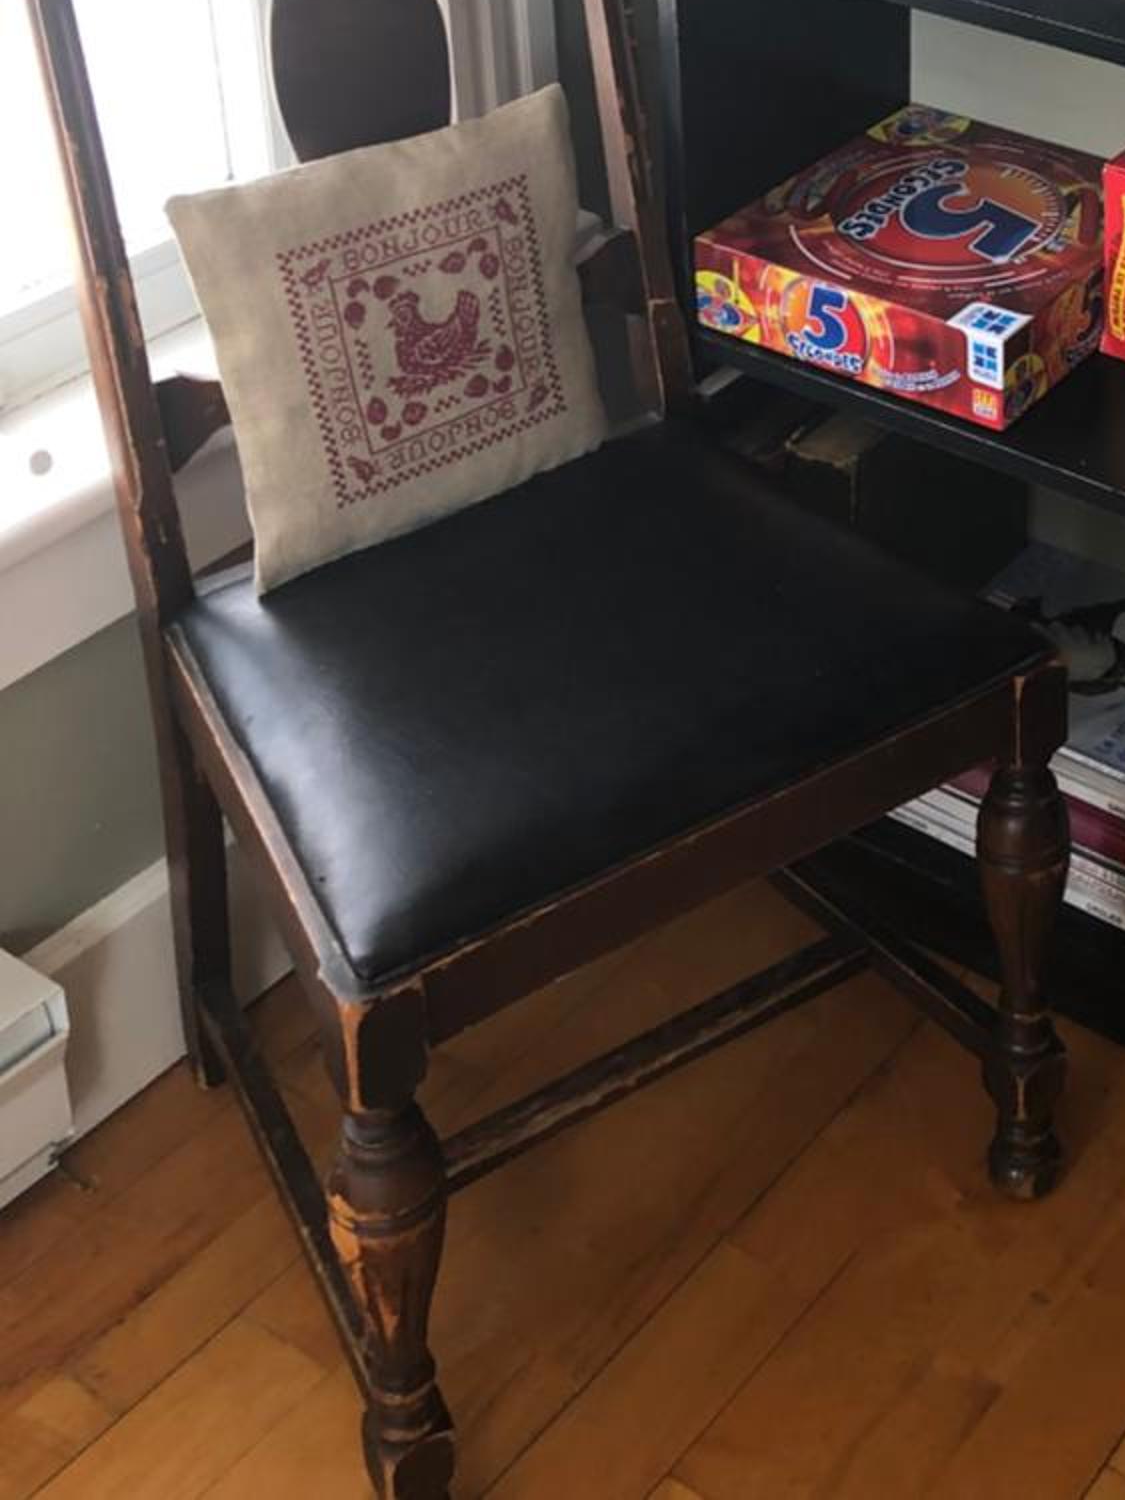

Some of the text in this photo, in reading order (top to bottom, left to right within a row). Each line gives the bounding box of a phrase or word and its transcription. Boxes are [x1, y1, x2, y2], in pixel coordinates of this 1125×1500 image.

[837, 159, 968, 242] SECONDES
[900, 183, 1042, 262] 5
[341, 212, 485, 272] BONJOUR
[504, 237, 543, 374] BONJOUR
[803, 283, 850, 350] 5
[310, 296, 364, 446] BONJOUR
[386, 400, 518, 471] BONJOUR
